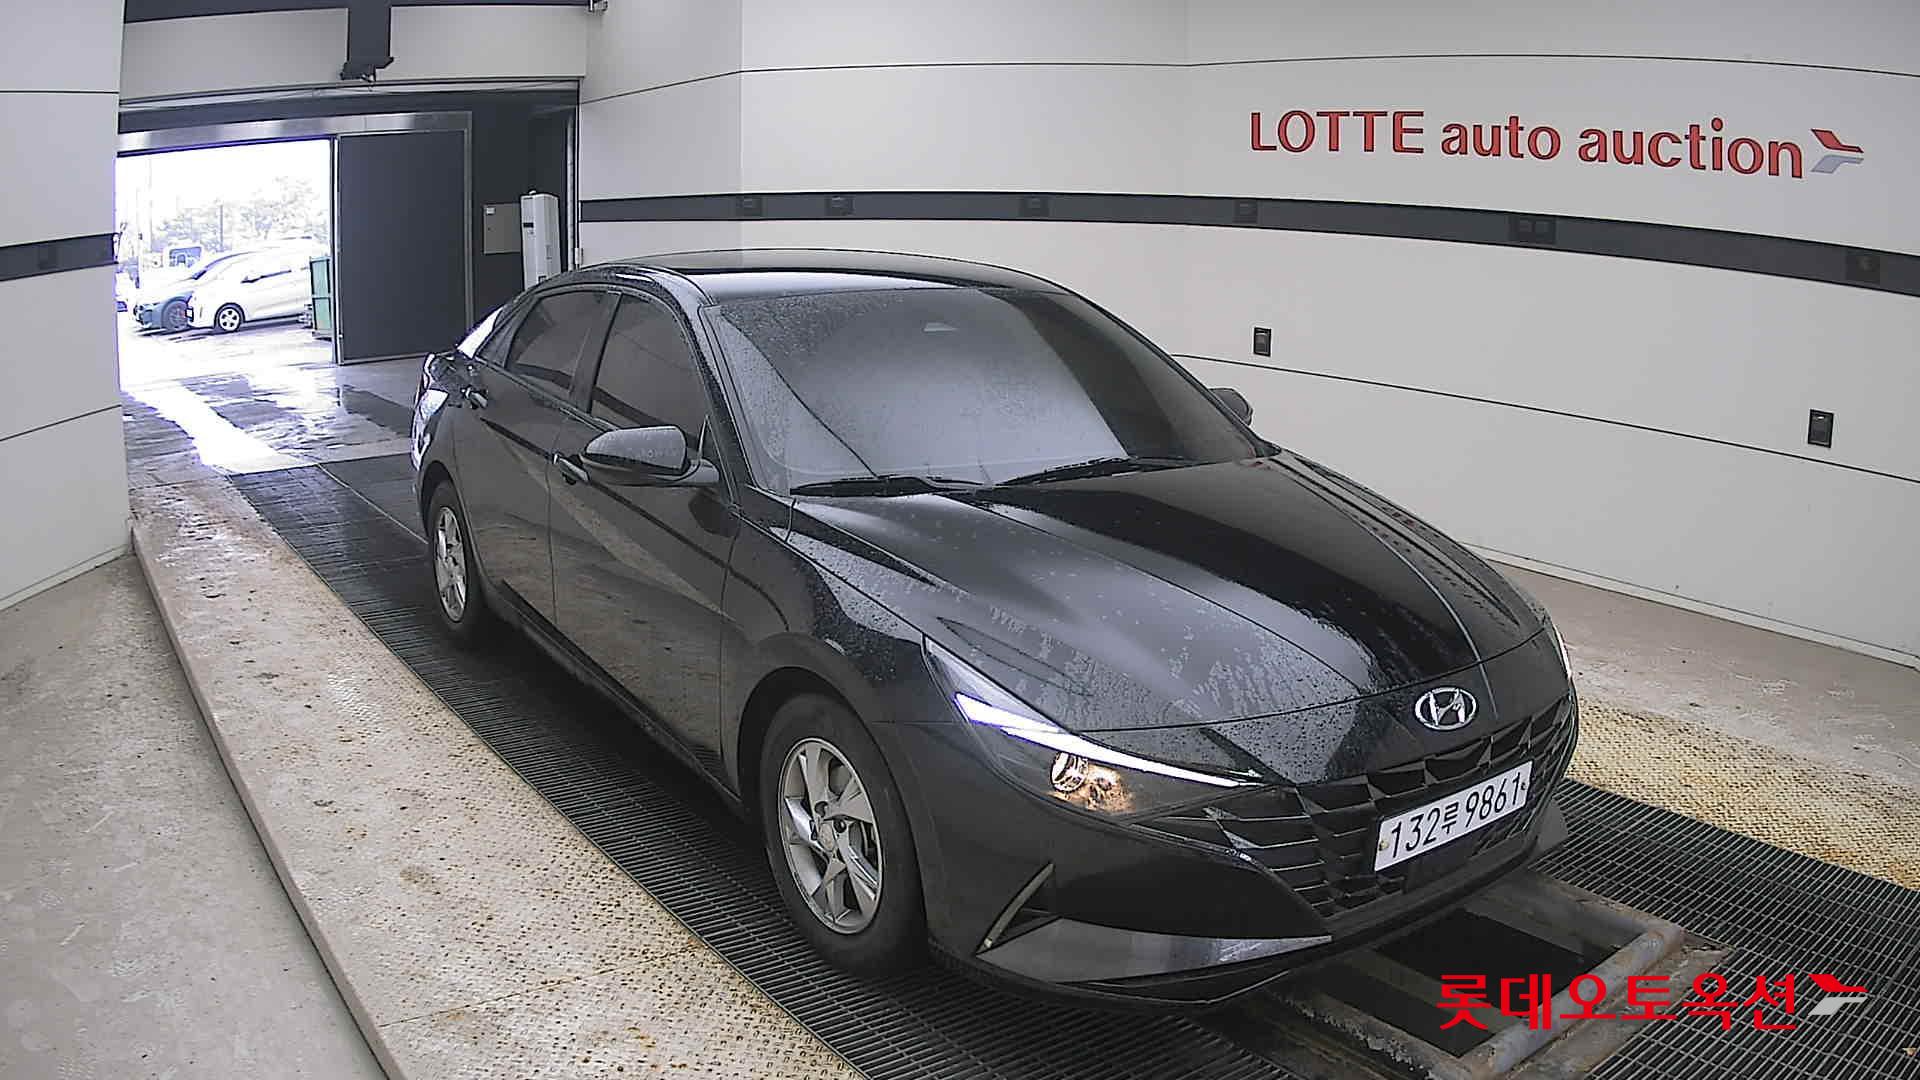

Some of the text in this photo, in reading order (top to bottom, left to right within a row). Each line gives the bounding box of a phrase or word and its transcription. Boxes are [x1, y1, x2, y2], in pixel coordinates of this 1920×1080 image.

[1250, 110, 1804, 178] LOTTE auto auction
[1465, 771, 1522, 828] 9861
